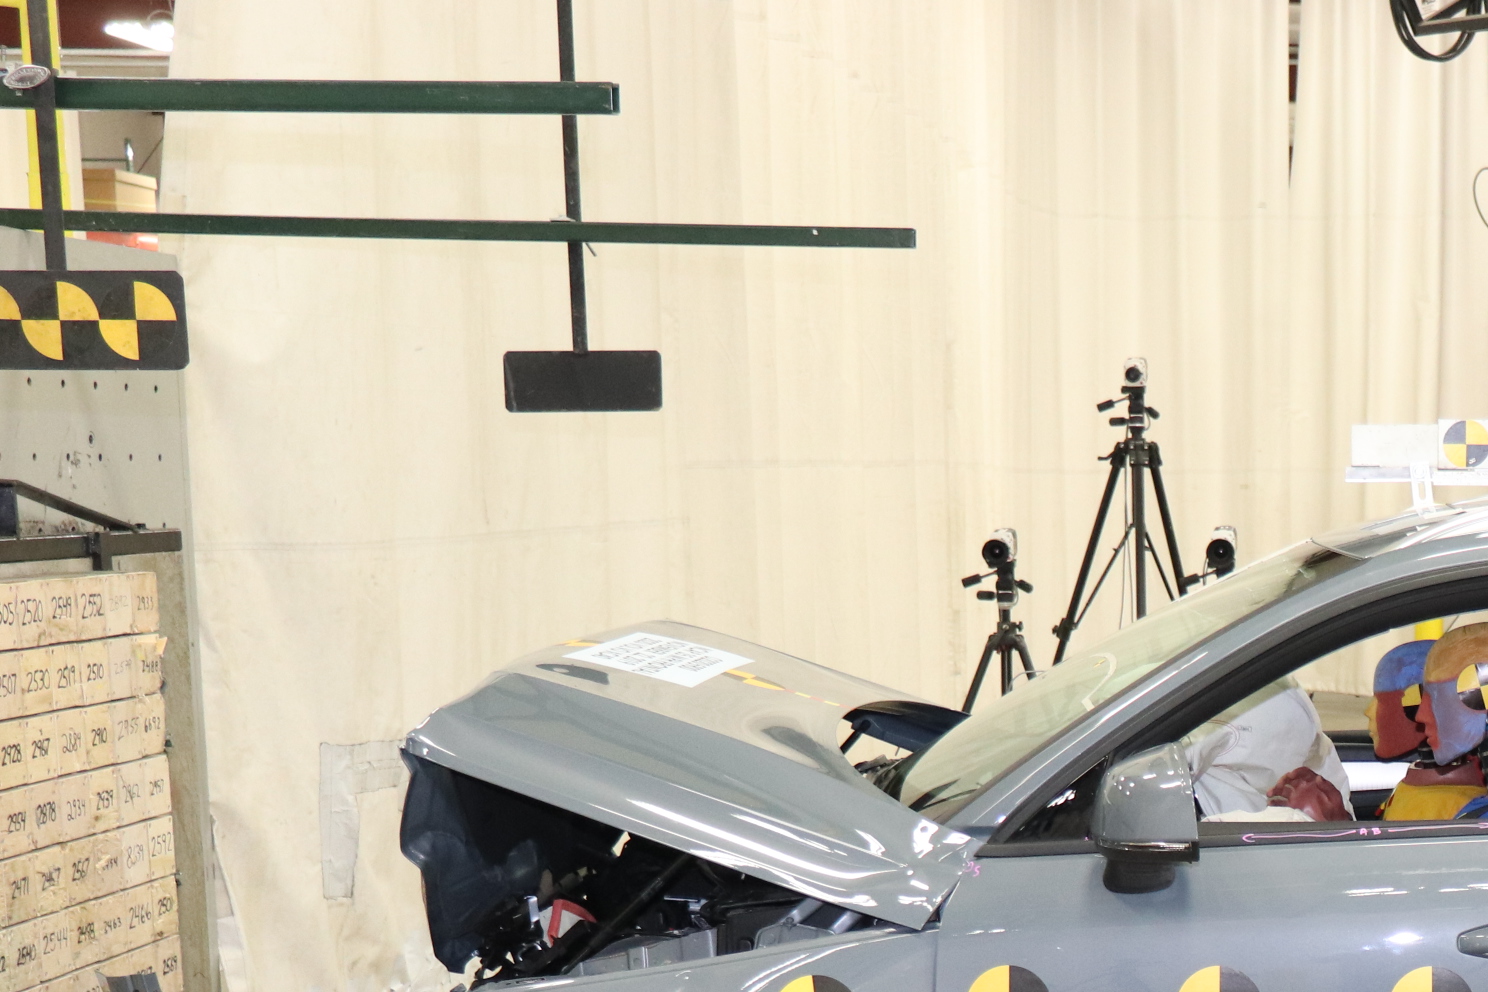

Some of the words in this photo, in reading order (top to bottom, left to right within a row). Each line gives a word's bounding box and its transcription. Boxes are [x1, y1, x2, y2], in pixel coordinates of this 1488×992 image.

[21, 599, 43, 626] 2520
[26, 668, 50, 693] 2530
[66, 799, 86, 821] 2934
[151, 832, 173, 857] 2592
